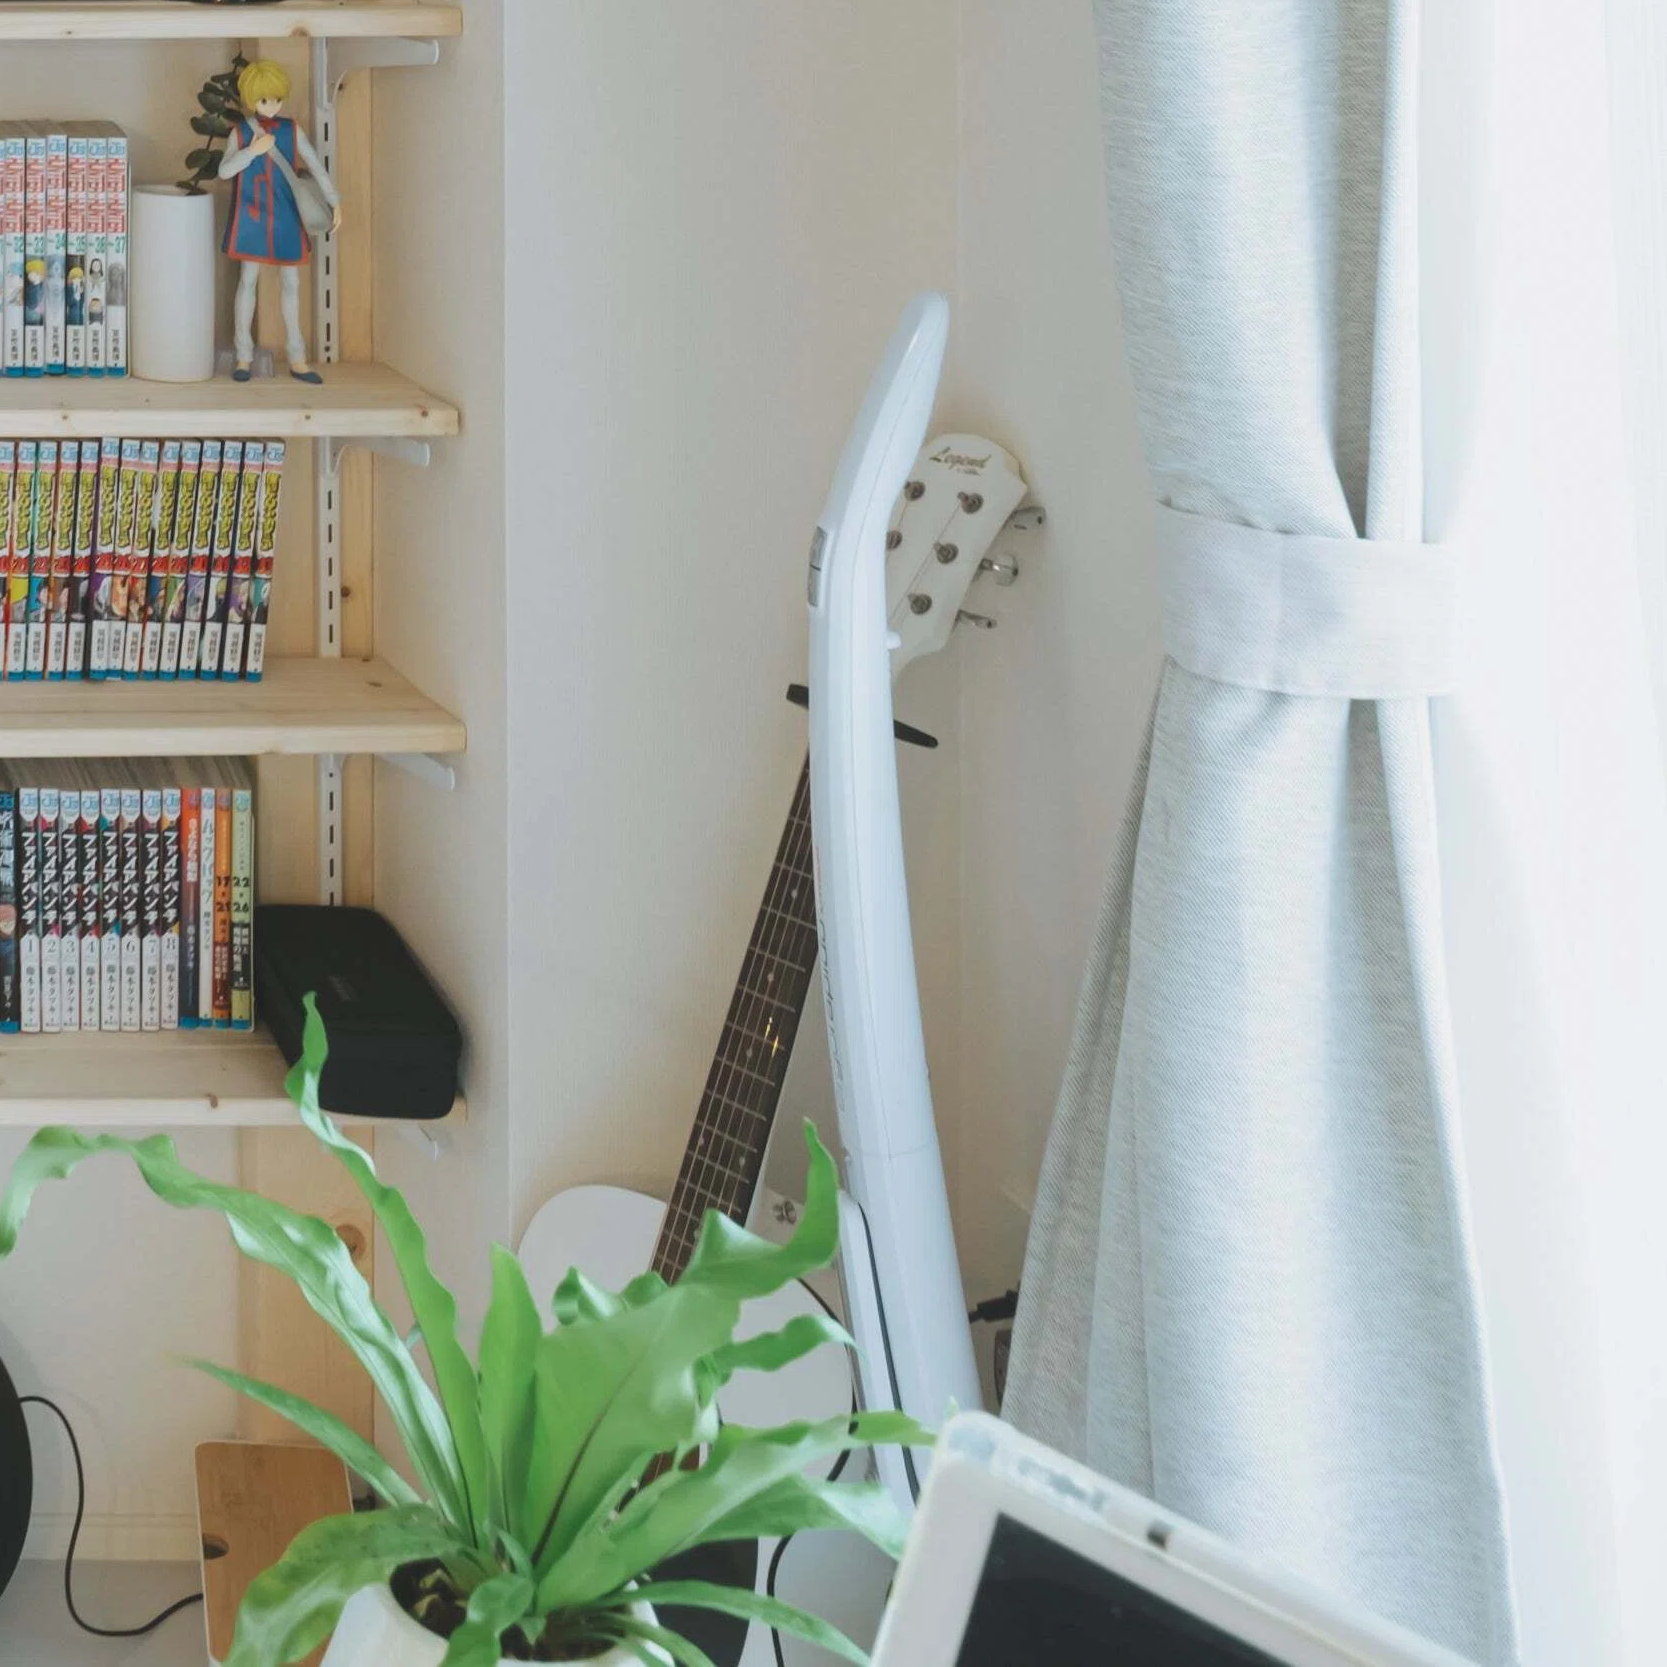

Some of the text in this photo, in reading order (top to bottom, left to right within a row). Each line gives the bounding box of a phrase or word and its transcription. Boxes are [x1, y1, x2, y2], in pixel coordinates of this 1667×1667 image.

[233, 877, 250, 888] 22
[233, 902, 250, 913] 26
[27, 939, 33, 953] 1
[48, 939, 57, 953] 2
[66, 939, 75, 953] 3
[86, 939, 95, 953] 4
[106, 937, 116, 951] 5
[126, 937, 135, 952] 6
[148, 940, 157, 953] 7
[166, 936, 175, 950] 8
